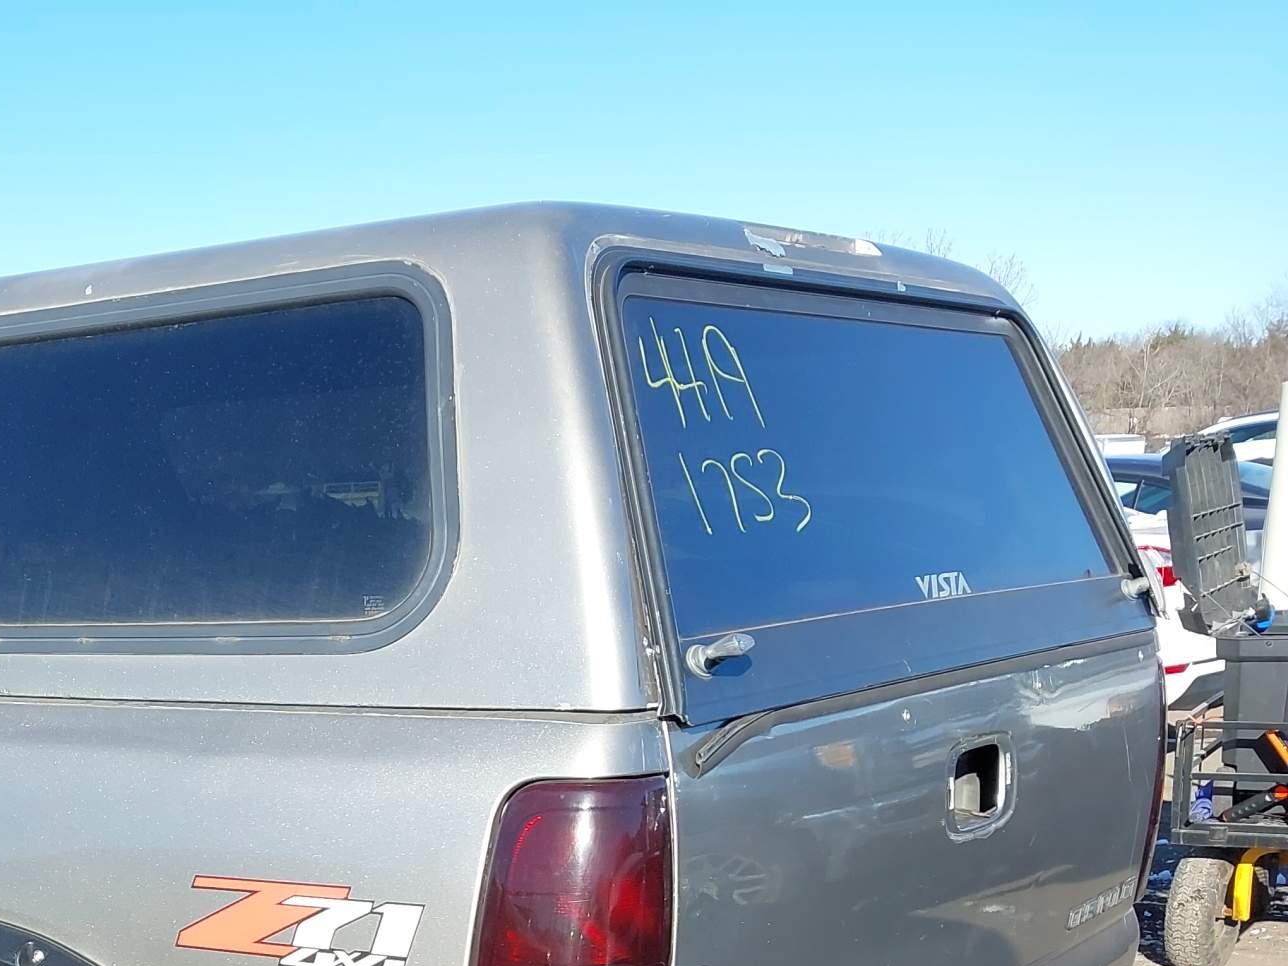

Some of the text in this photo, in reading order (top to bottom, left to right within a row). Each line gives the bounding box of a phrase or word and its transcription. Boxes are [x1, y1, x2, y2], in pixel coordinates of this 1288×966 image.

[678, 449, 812, 535] 1753
[914, 571, 972, 600] VISTA
[175, 874, 426, 961] Z71
